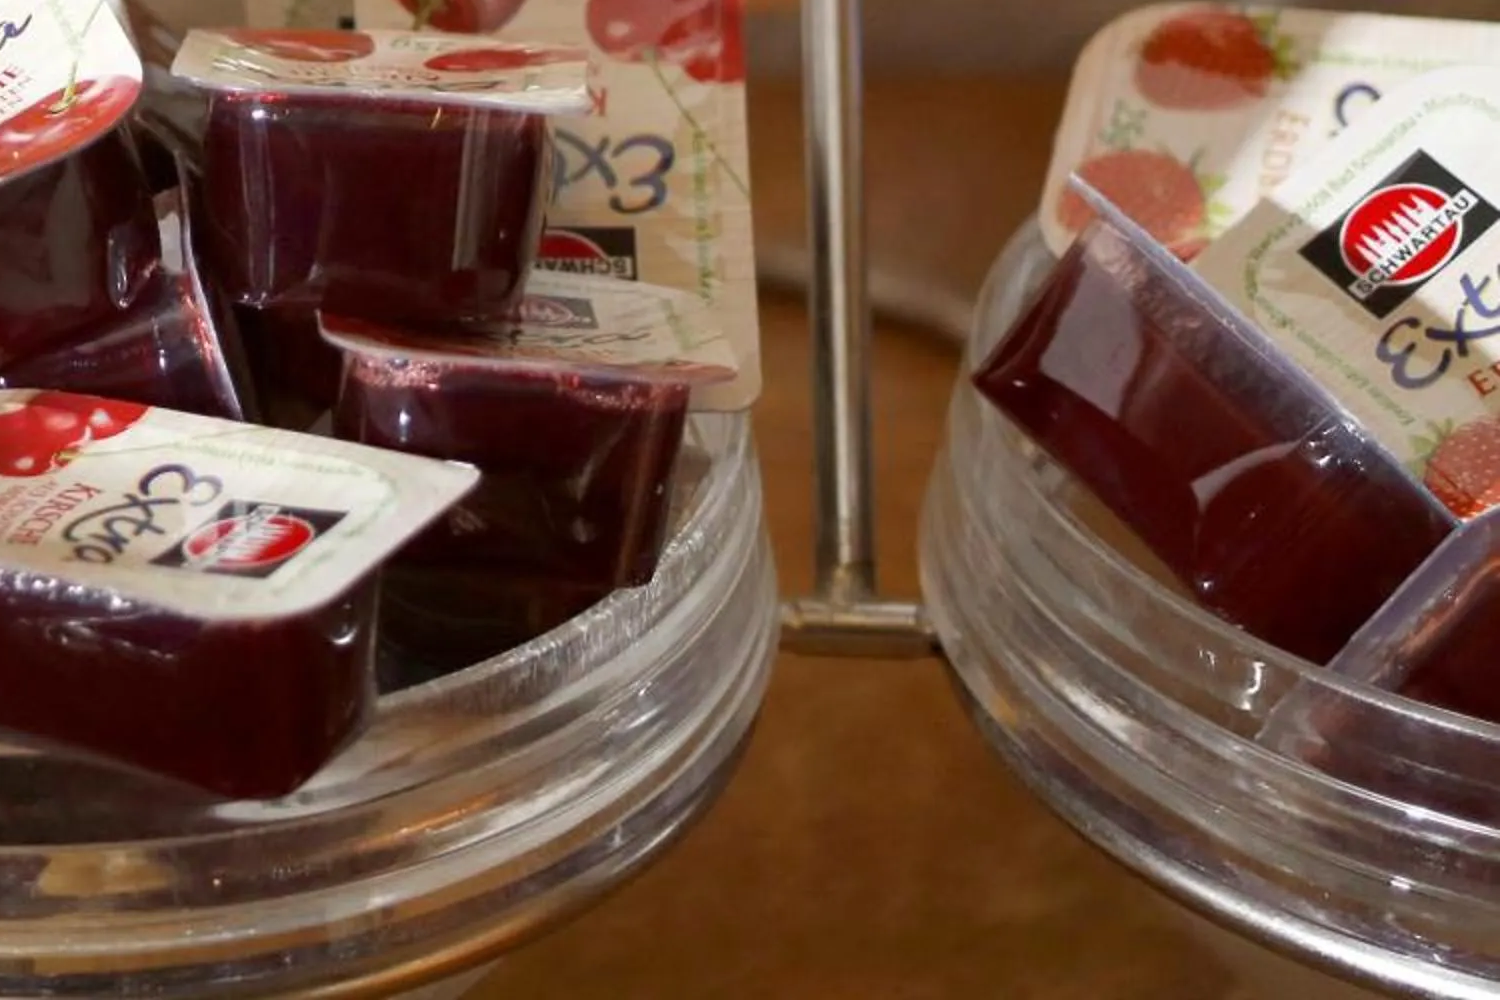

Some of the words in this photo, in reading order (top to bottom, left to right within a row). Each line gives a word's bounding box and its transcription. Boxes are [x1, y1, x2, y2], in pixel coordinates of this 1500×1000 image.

[1357, 195, 1470, 295] SCHWARTAU
[1376, 264, 1500, 390] Ext
[6, 482, 102, 546] KIRSCHE
[63, 461, 224, 565] Extra
